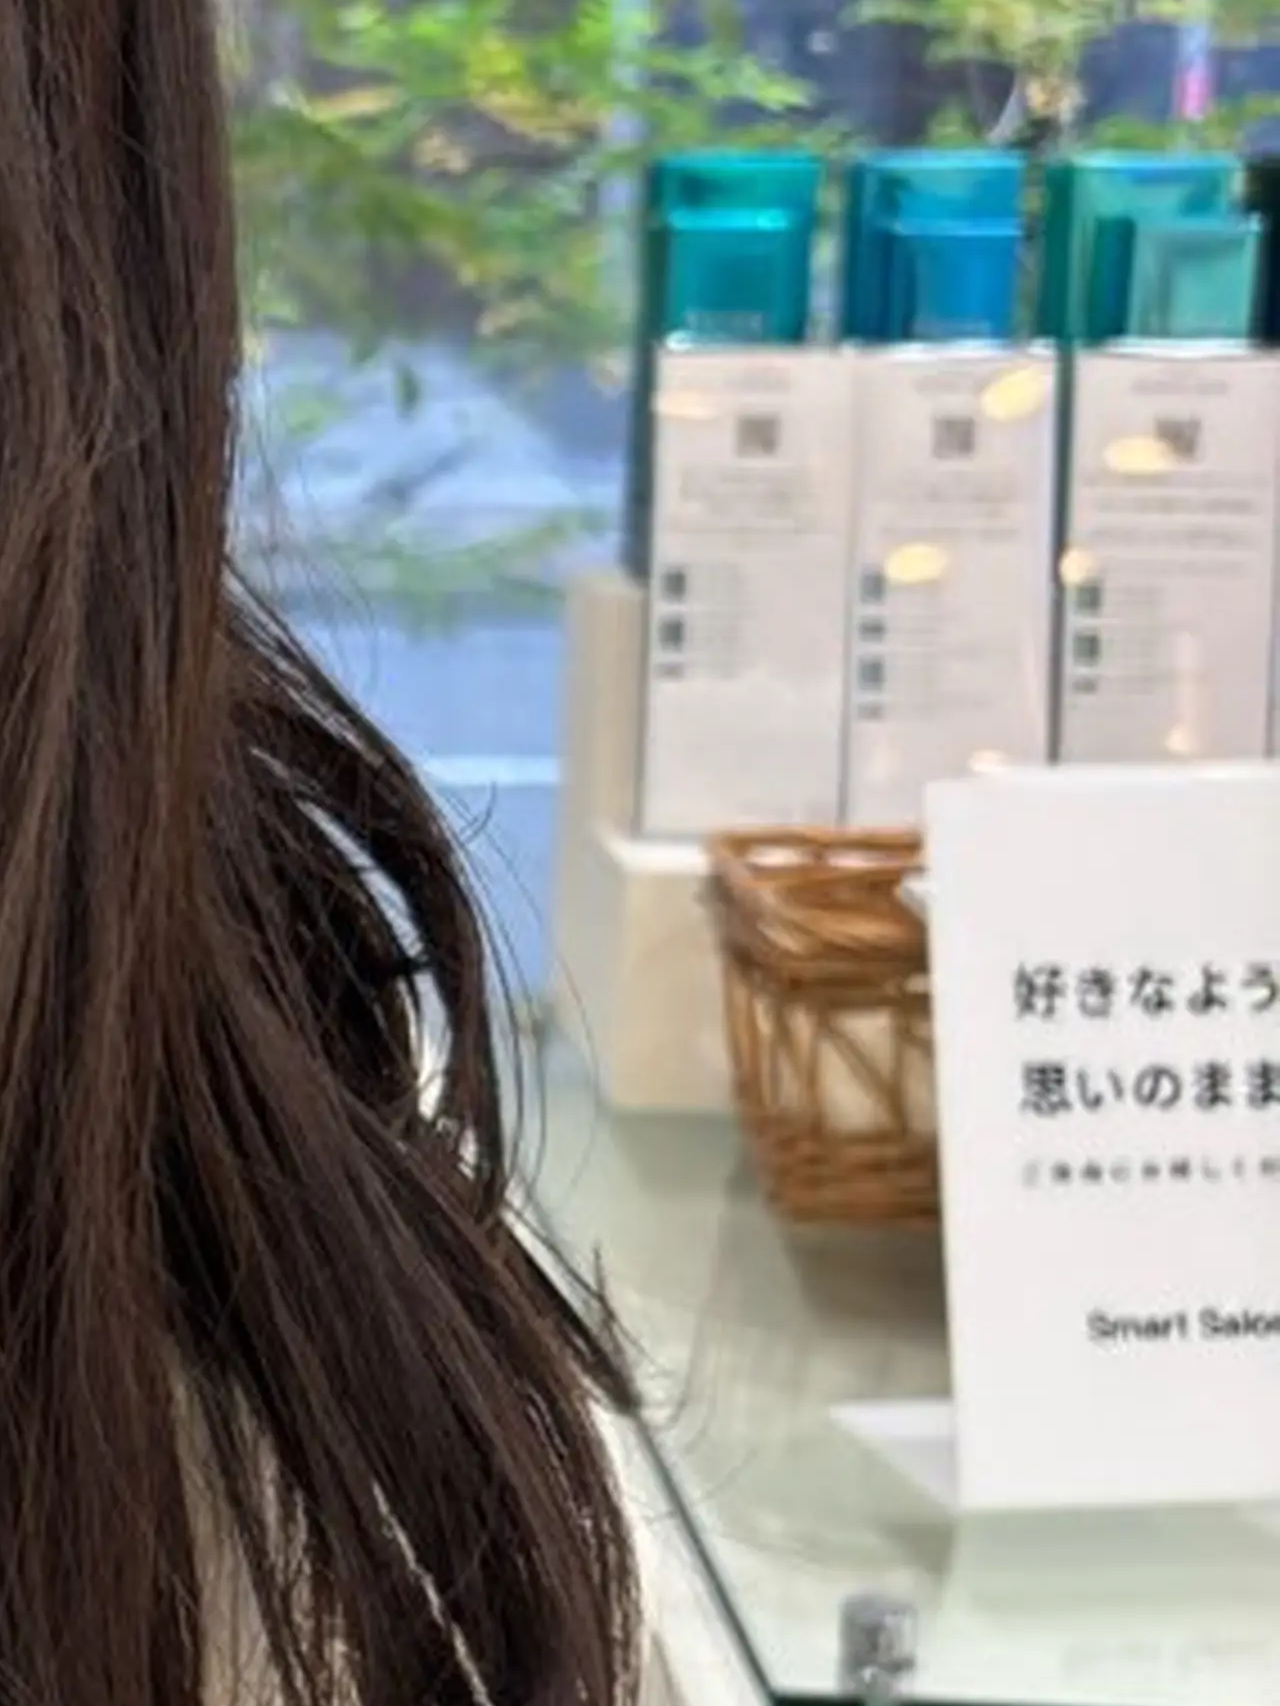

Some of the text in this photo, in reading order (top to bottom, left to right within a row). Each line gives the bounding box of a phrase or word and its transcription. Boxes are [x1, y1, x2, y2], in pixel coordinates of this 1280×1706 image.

[1013, 961, 1280, 1021] 好きなよう
[1020, 1057, 1280, 1117] 思いのまま
[1087, 1309, 1188, 1341] Smart
